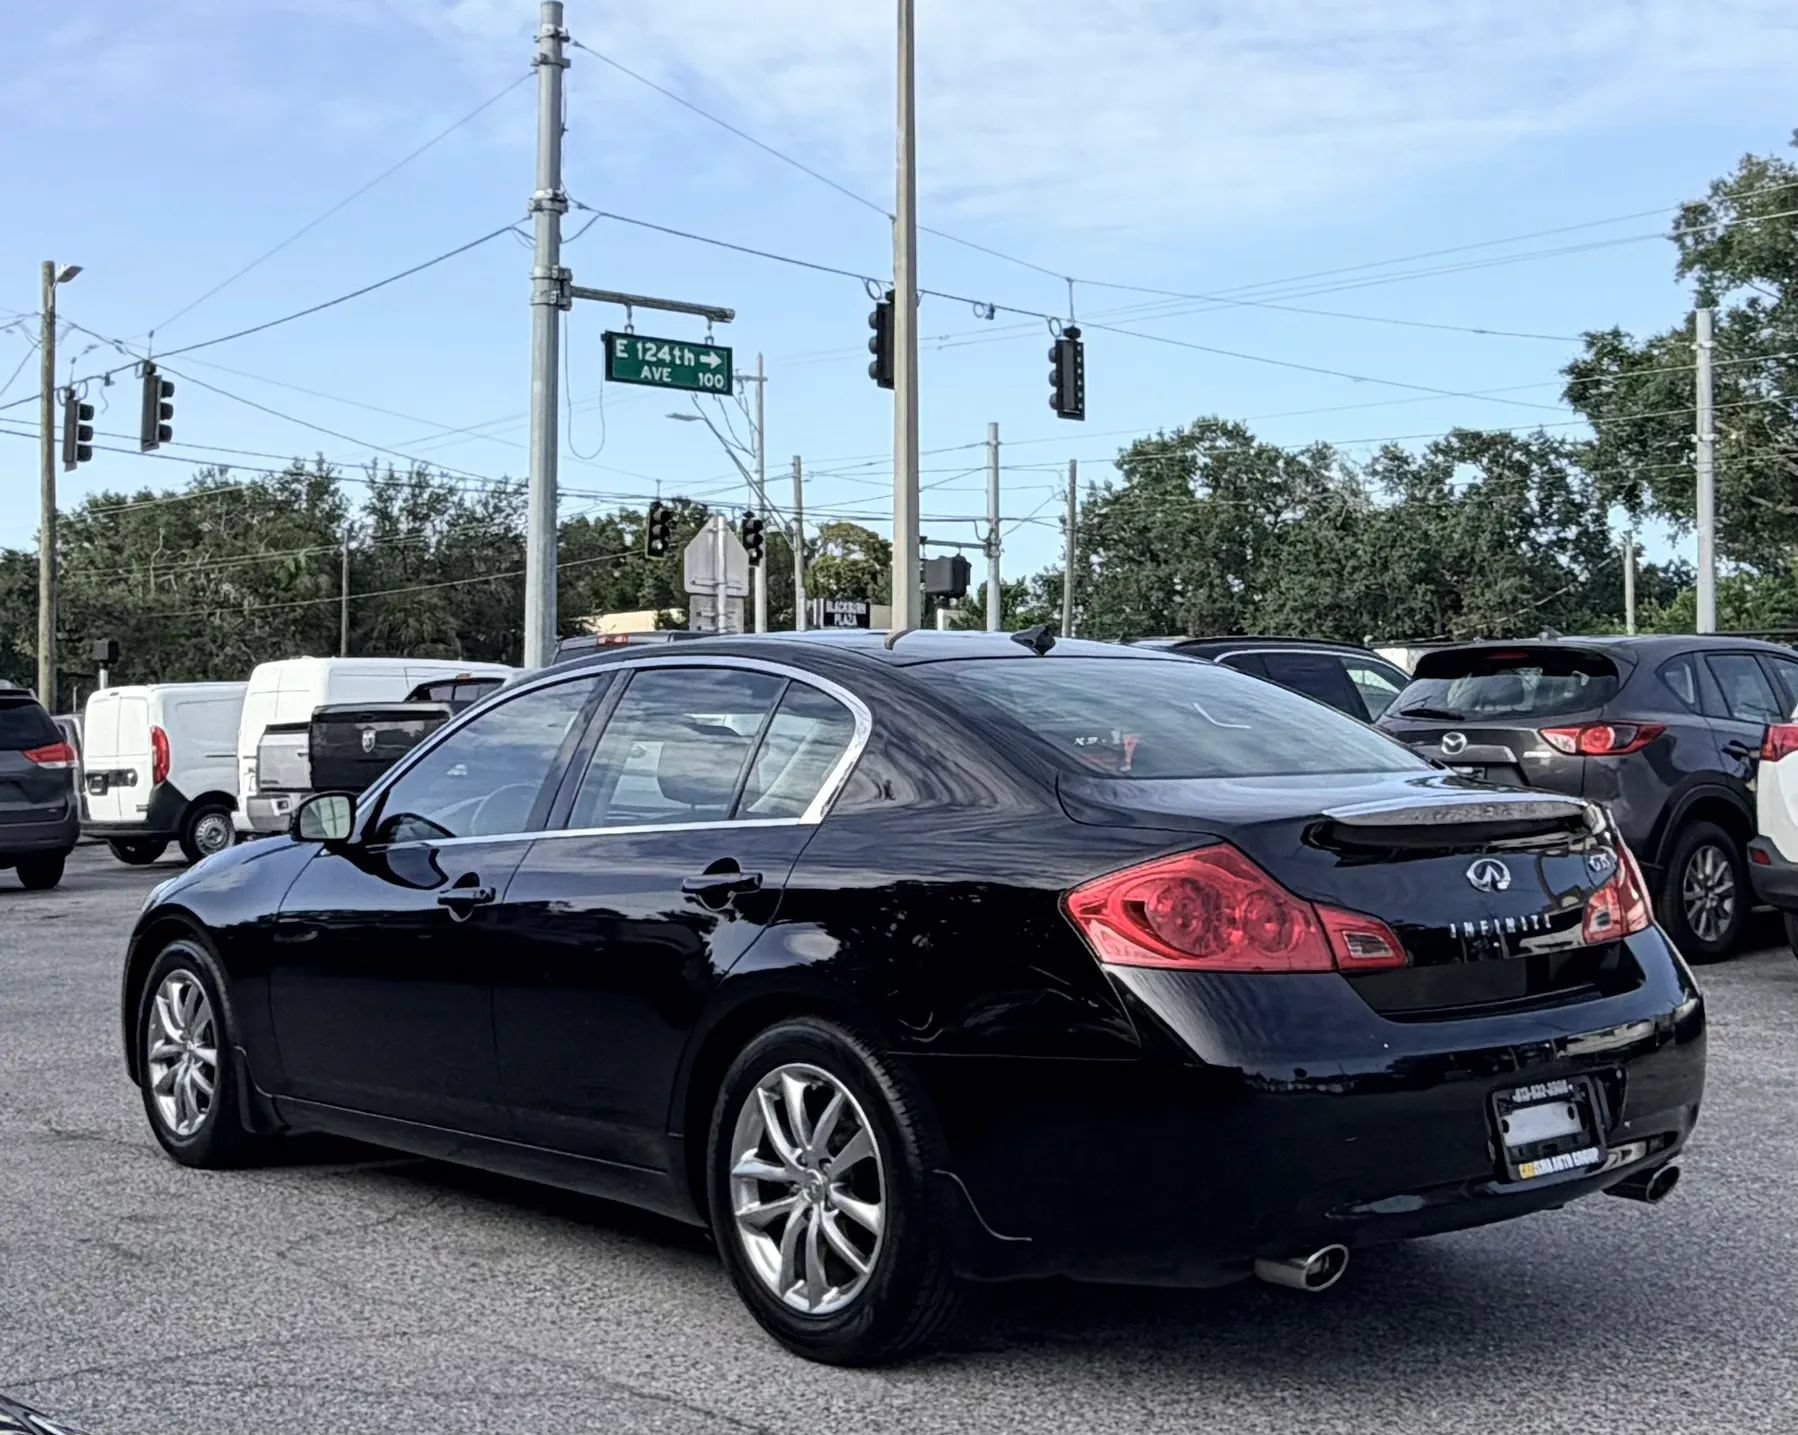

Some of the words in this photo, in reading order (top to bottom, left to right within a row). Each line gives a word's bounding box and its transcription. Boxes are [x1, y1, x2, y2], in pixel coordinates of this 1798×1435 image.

[615, 339, 629, 358] E
[637, 341, 696, 367] 124th
[640, 365, 672, 382] AVE
[698, 372, 725, 389] 100
[834, 613, 858, 626] PLAZA
[1450, 913, 1552, 938] INFINITI
